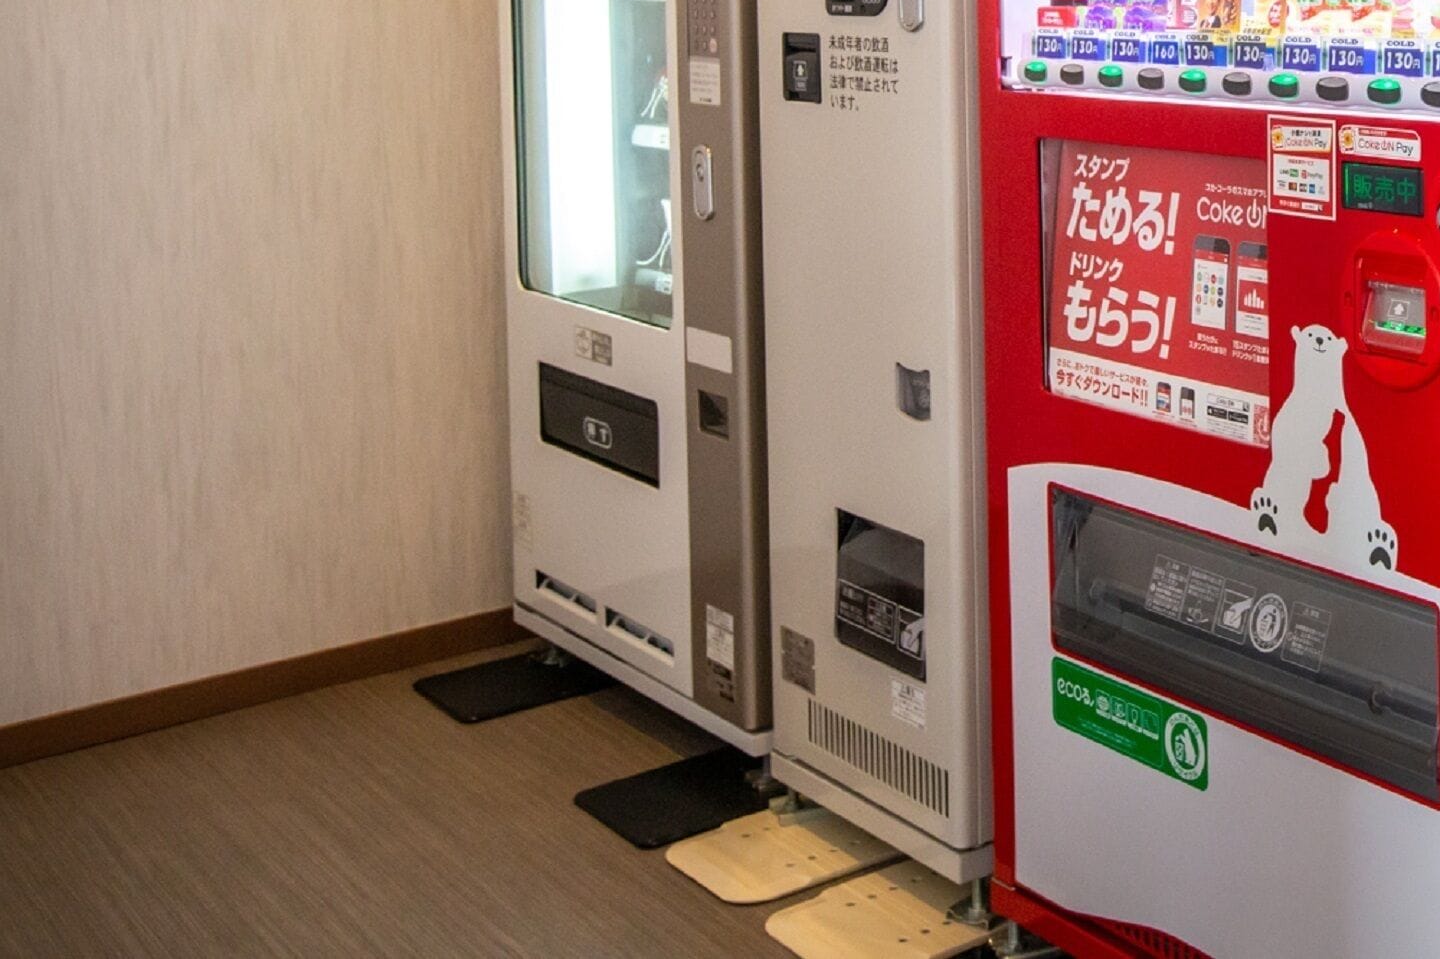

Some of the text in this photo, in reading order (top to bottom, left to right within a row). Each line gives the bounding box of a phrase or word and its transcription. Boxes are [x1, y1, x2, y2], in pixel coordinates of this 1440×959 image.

[829, 35, 889, 53] 未成年者の飲酒
[1285, 48, 1316, 64] 130円
[1332, 50, 1364, 67] 130円
[1387, 52, 1420, 70] 130円
[830, 96, 860, 112] います。
[1314, 139, 1327, 149] Pay
[1358, 138, 1381, 150] Coke
[1396, 142, 1414, 156] Pay
[1074, 154, 1130, 181] スタンプ
[1353, 174, 1417, 204] 販売中
[1066, 181, 1179, 255] ためる!
[1197, 196, 1243, 225] Coke
[1070, 251, 1124, 282] ドリンク
[1064, 280, 1177, 359] もらう!
[1056, 371, 1149, 408] 今すぐダウンロード!!
